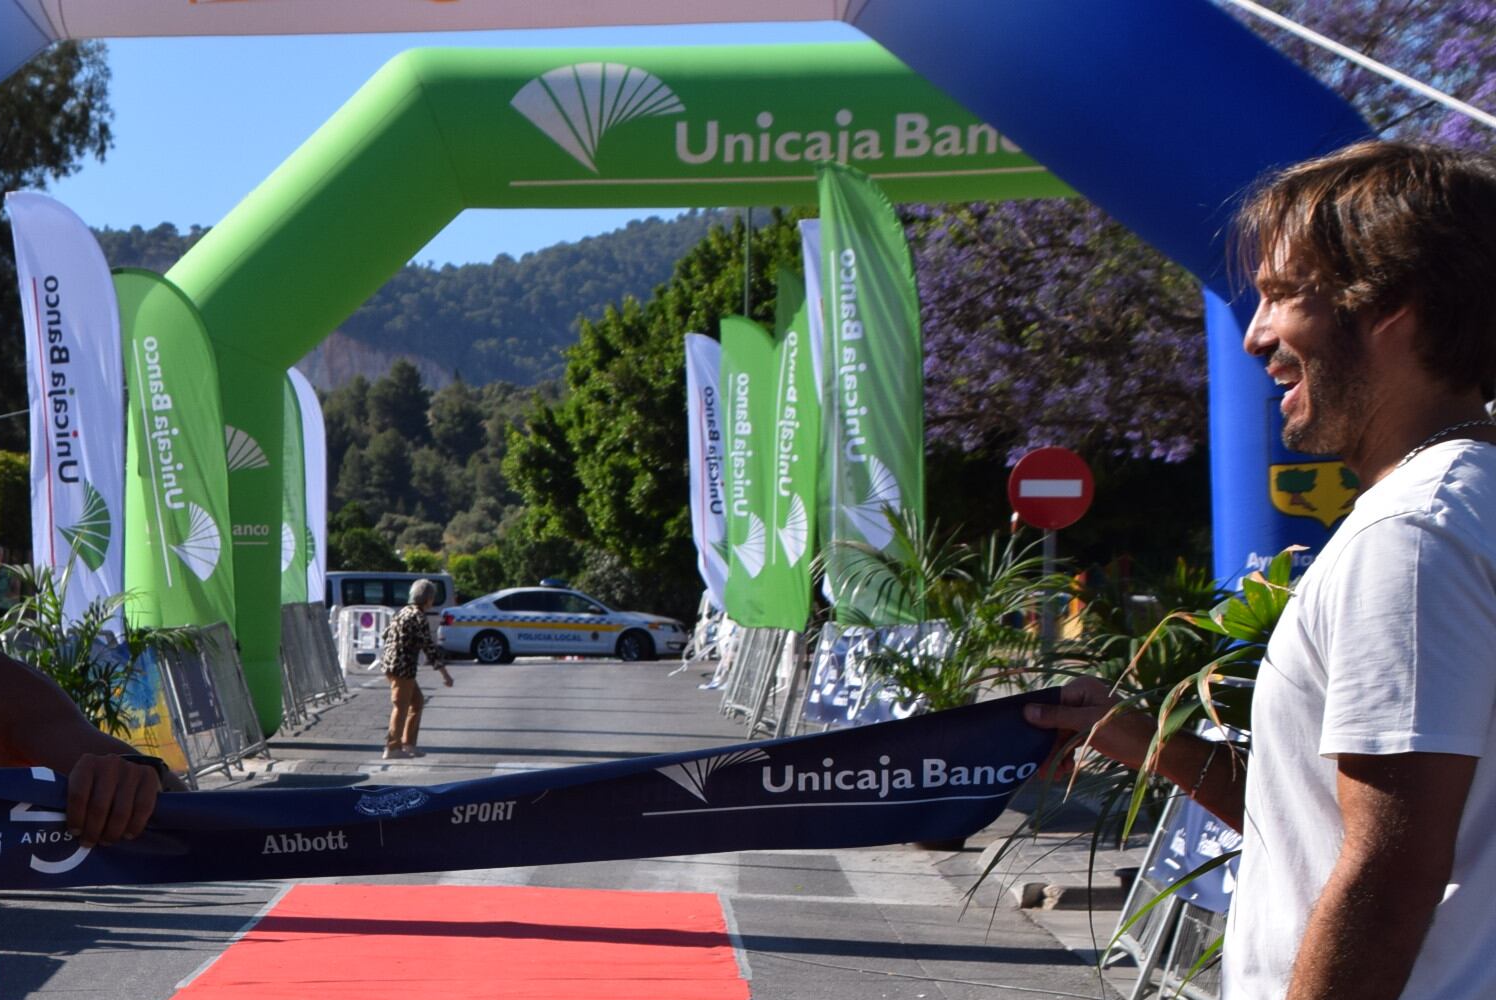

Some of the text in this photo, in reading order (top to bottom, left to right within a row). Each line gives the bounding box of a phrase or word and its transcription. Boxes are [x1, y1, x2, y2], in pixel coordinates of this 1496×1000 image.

[675, 109, 1022, 165] Unicaja Banc
[232, 523, 270, 536] anco
[554, 633, 583, 642] LOCAL
[762, 755, 1039, 798] Unicaja Banco
[451, 801, 517, 825] SPORT
[20, 829, 73, 844] AÑOS
[261, 829, 348, 855] Abbott
